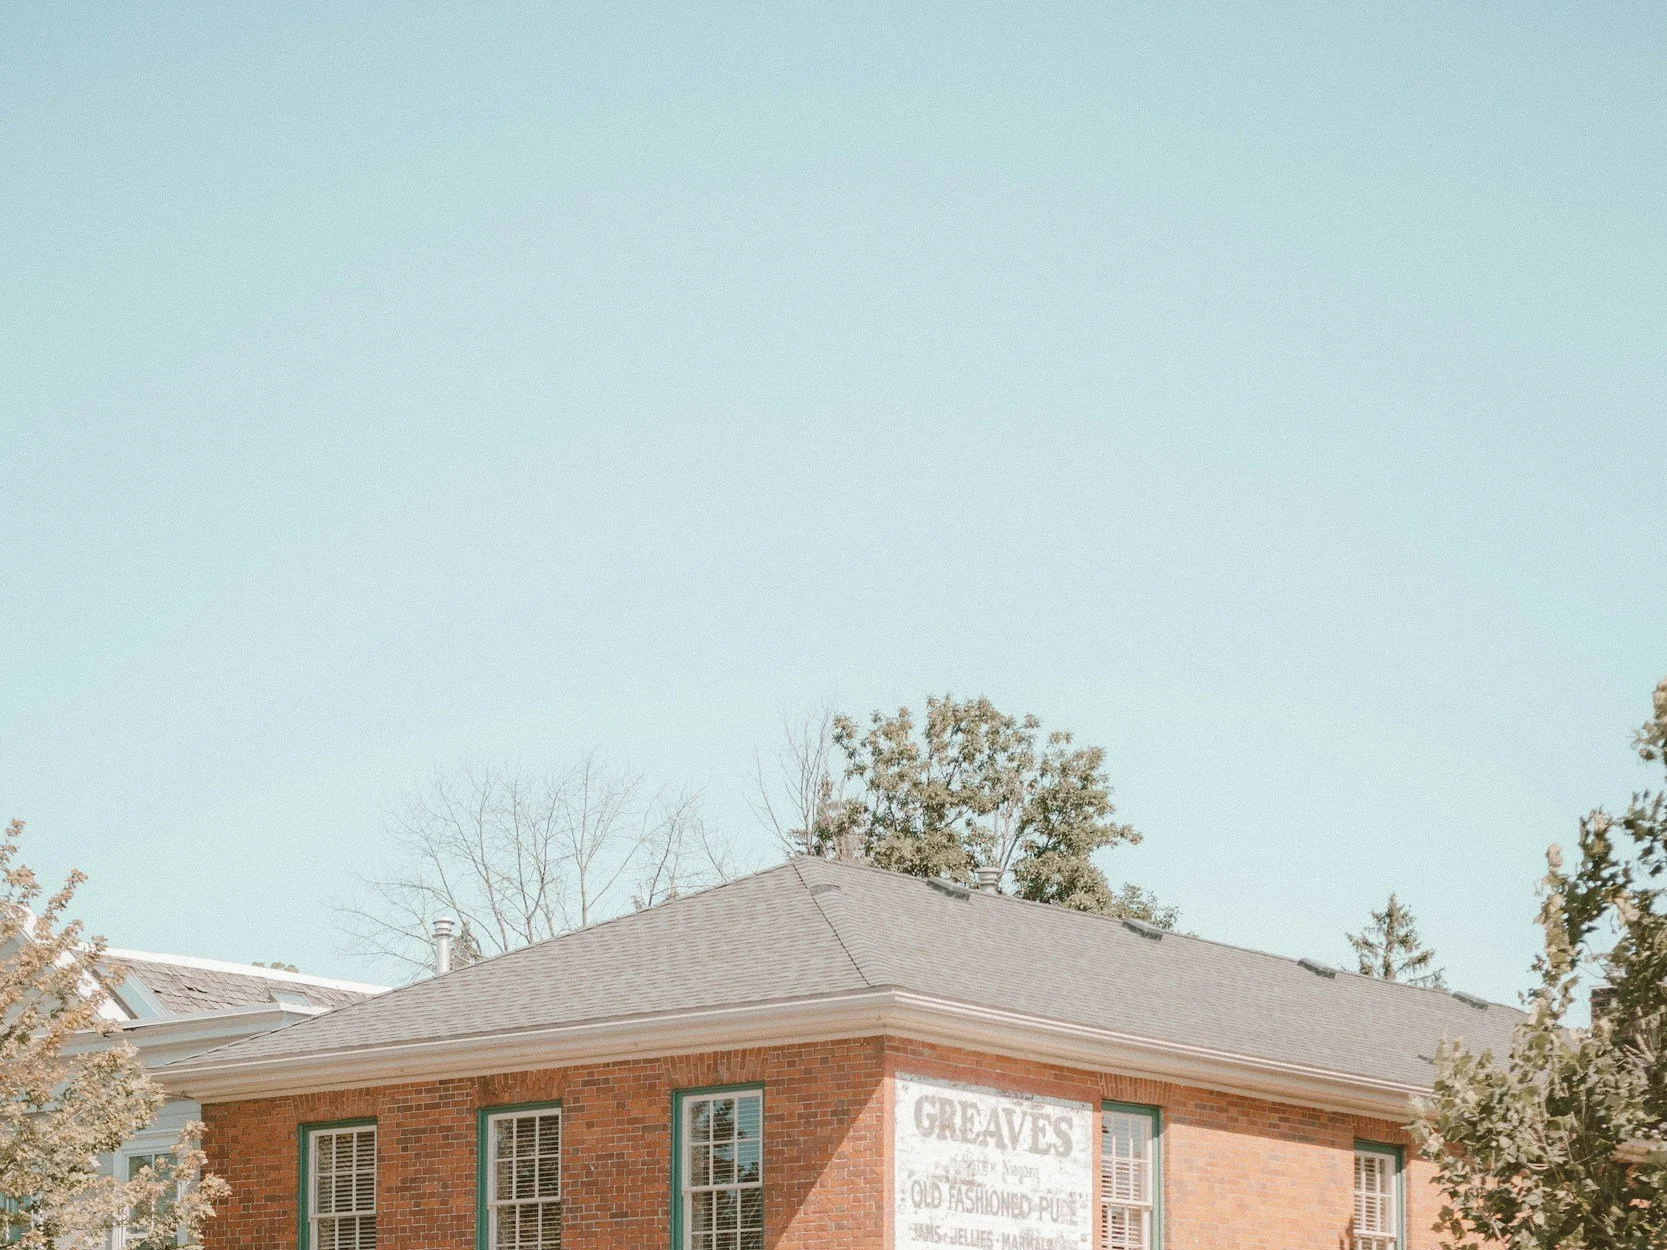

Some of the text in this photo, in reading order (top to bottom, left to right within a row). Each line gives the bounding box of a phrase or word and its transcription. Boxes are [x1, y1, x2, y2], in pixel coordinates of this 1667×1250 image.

[913, 1094, 1074, 1158] GREAVES
[949, 1184, 1031, 1222] FASHIONED
[1038, 1194, 1079, 1226] PUE
[950, 1226, 994, 1249] JELLIES
